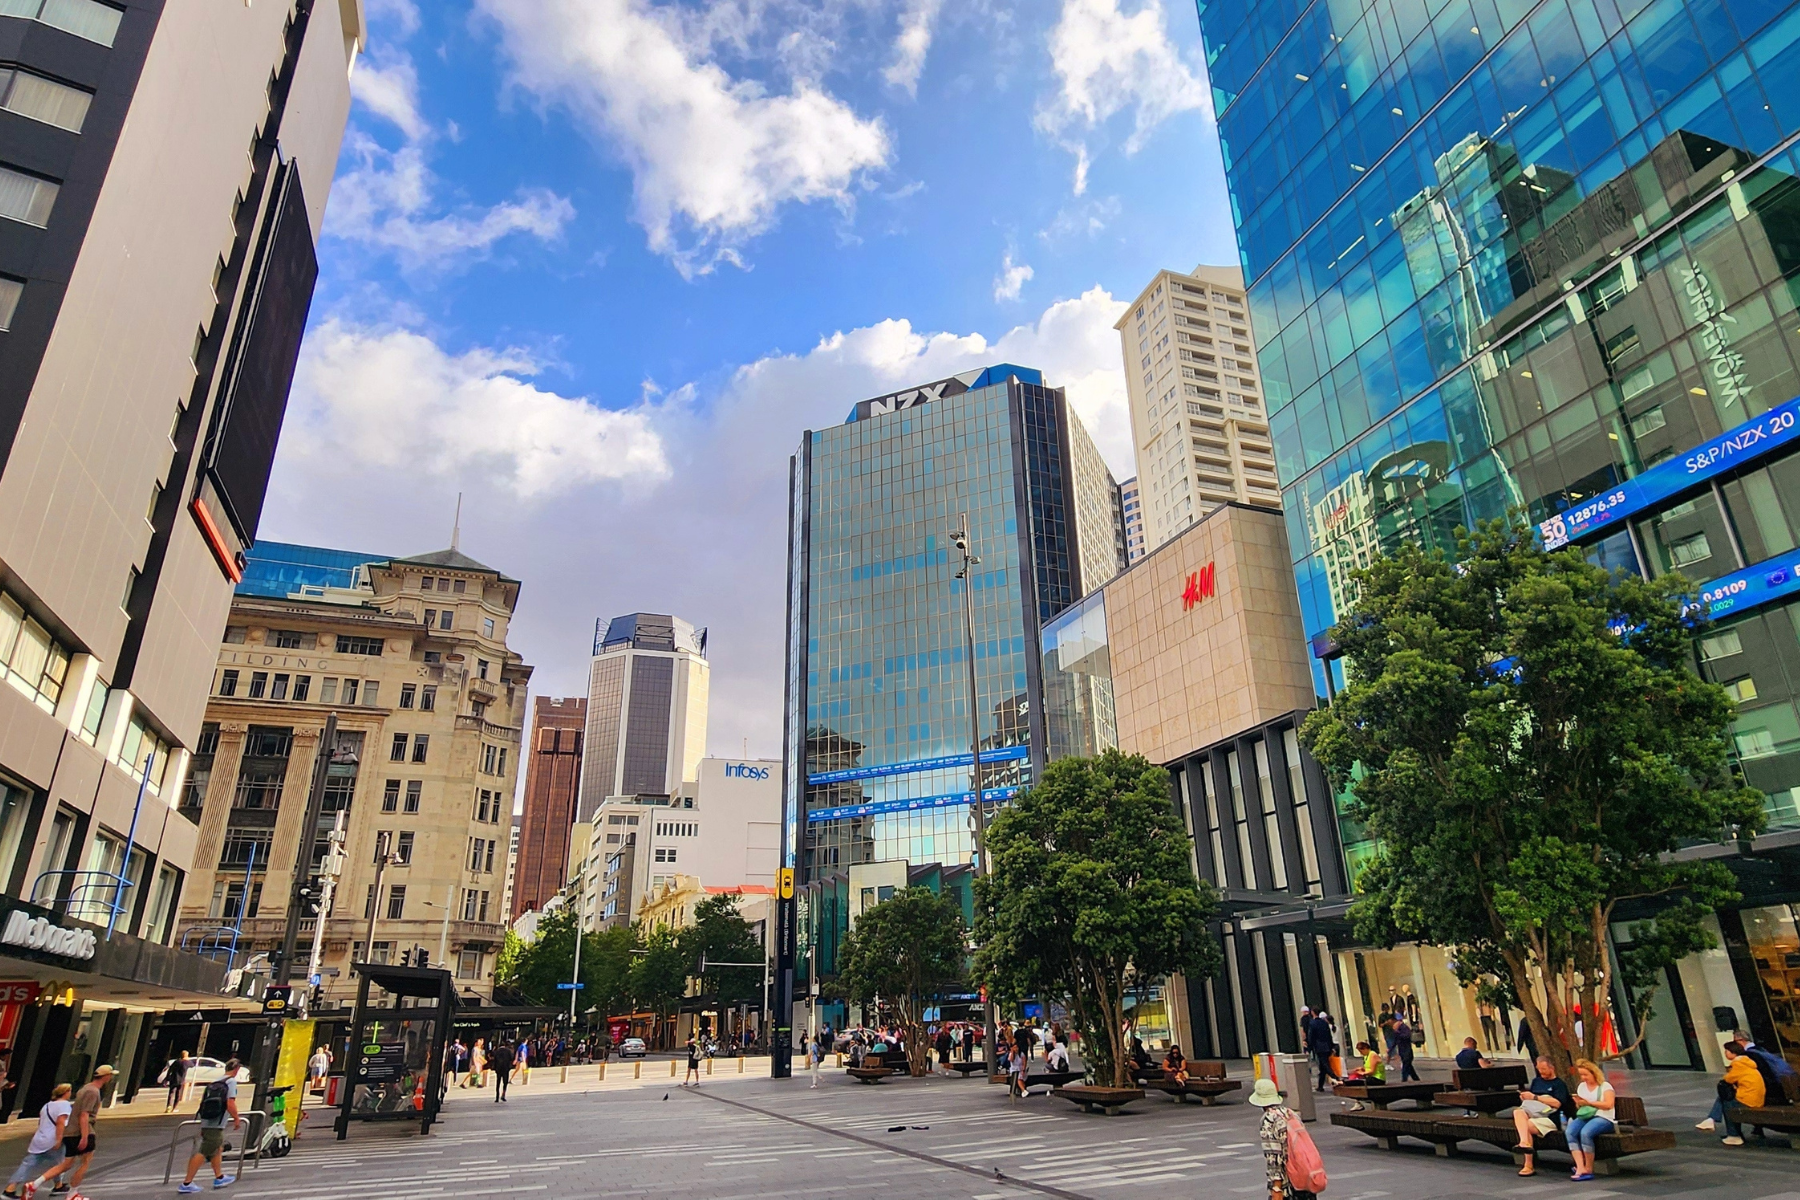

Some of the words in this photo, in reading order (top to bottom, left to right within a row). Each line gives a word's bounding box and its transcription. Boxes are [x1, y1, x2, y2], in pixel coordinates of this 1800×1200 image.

[1685, 424, 1768, 474] S&P/NZX
[1769, 411, 1795, 434] 20
[1567, 491, 1625, 525] 12876.35
[1541, 521, 1567, 544] 50
[1544, 534, 1569, 552] INDEX
[1181, 560, 1215, 612] H&M
[1702, 579, 1747, 603] 0.8109
[725, 762, 770, 781] Infosys
[2, 910, 97, 960] McDonald's
[968, 1003, 985, 1011] ANZ
